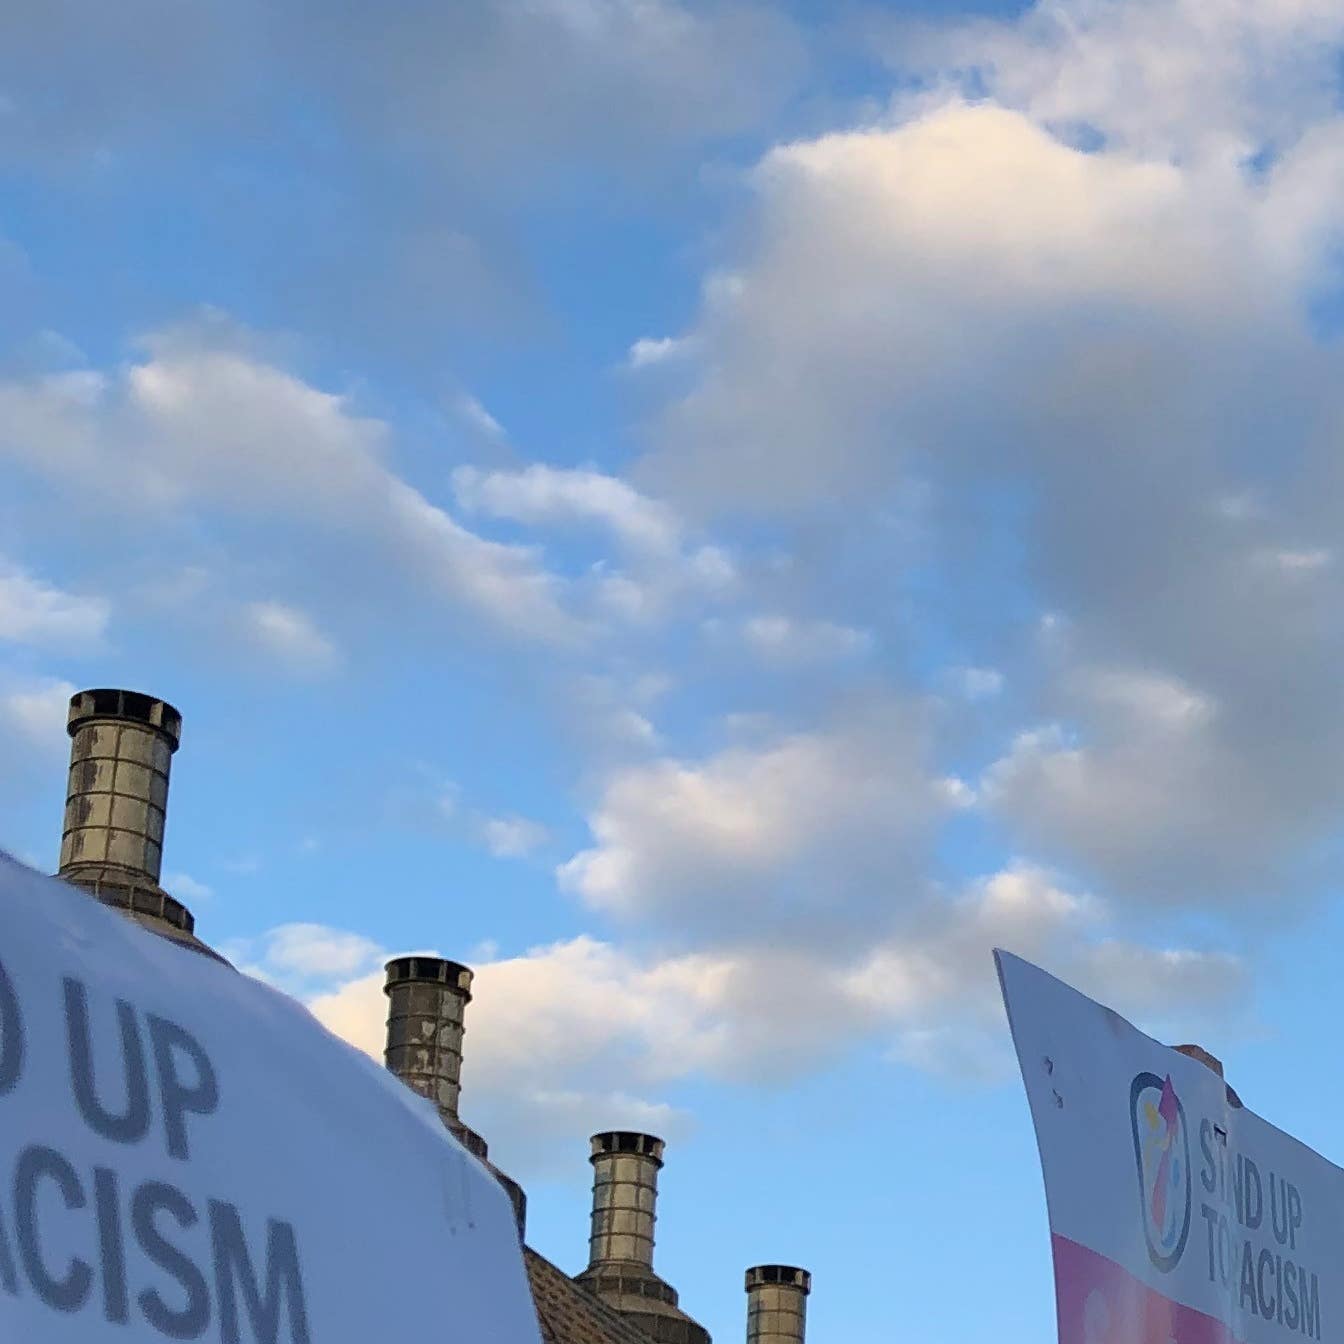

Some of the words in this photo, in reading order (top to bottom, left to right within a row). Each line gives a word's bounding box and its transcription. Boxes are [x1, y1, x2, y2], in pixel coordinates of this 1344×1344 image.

[62, 975, 220, 1161] UP
[1200, 1118, 1263, 1231] STND
[1270, 1172, 1301, 1250] UP
[1237, 1240, 1321, 1341] ACISM
